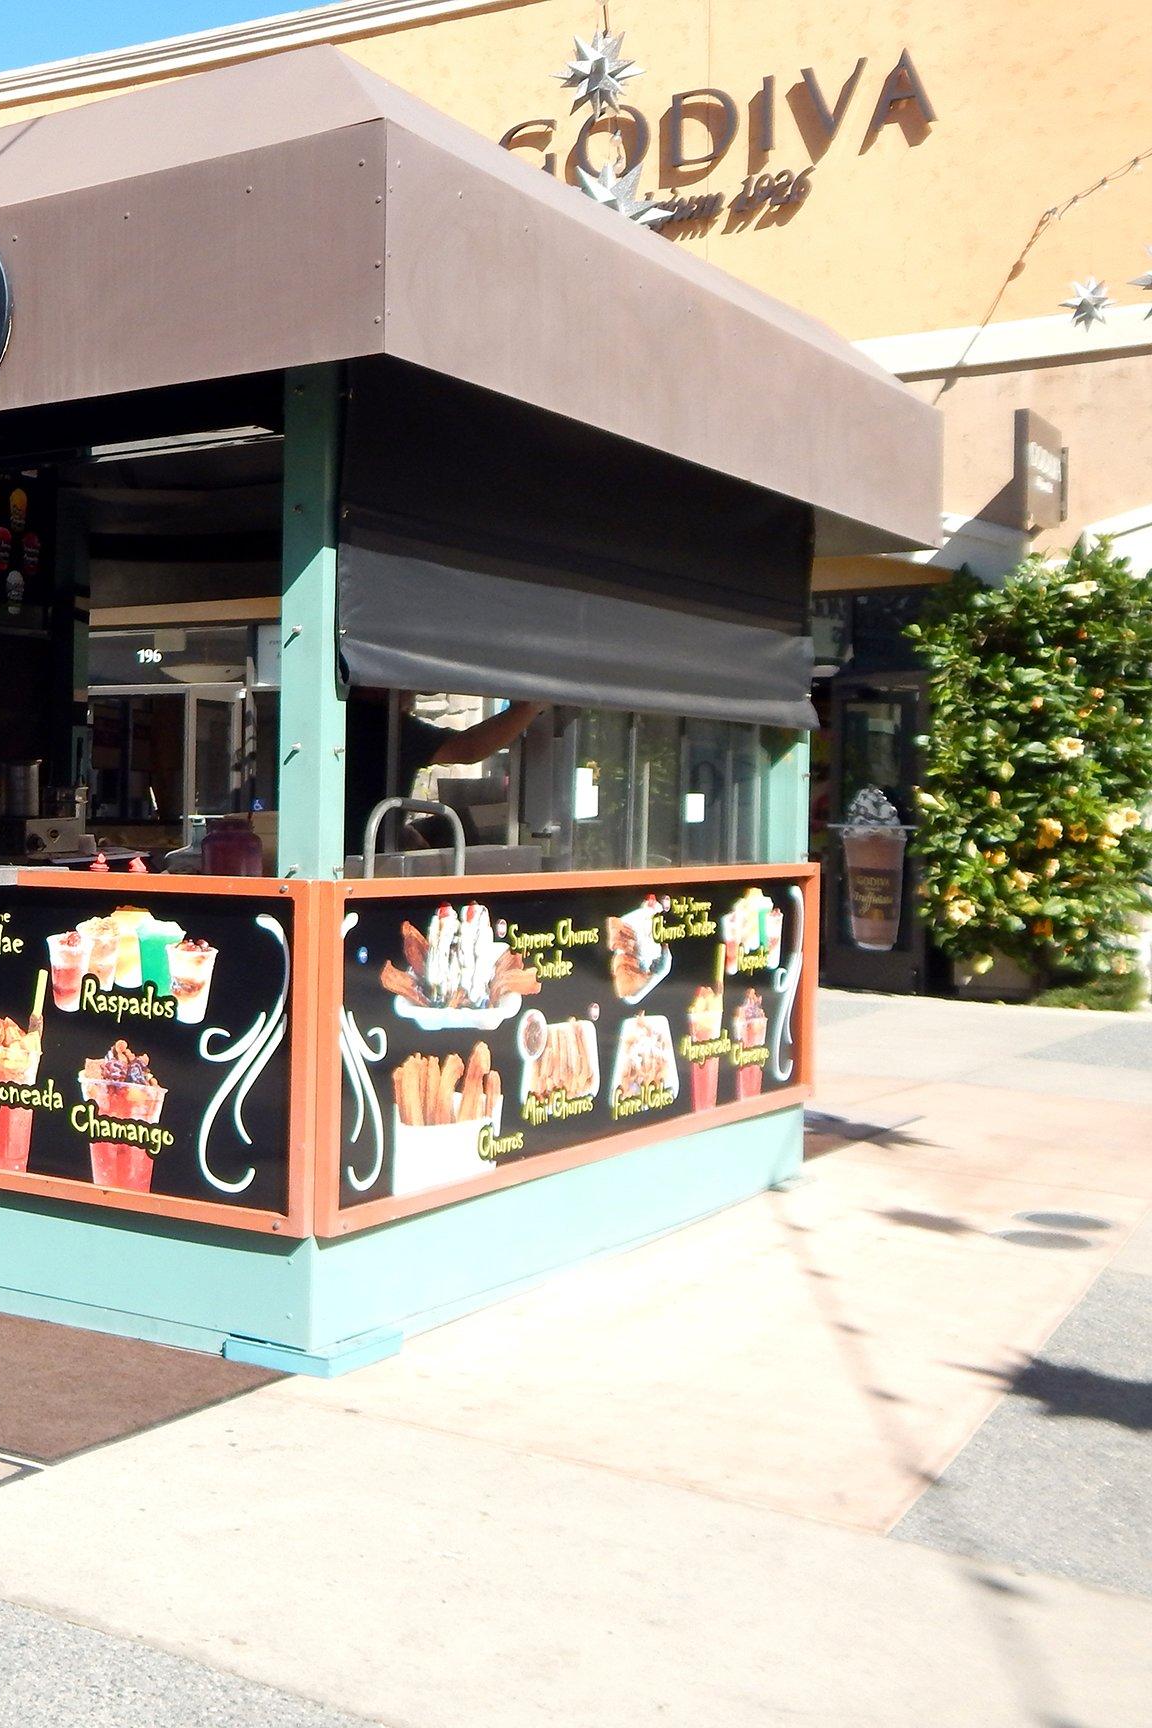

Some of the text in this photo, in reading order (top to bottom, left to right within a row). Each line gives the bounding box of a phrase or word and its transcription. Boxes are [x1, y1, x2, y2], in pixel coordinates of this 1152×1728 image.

[729, 166, 813, 214] 1926
[137, 649, 162, 663] 196
[509, 923, 555, 958] Supreme
[556, 917, 600, 947] Churros
[653, 911, 717, 942] Churros Sundae
[534, 949, 574, 979] Sundae
[82, 979, 176, 1023] Raspados
[524, 1090, 594, 1126] Mini Churros
[614, 1082, 674, 1120] Funnel Cakes
[70, 1105, 175, 1155] Chamango
[478, 1124, 524, 1161] Churros
